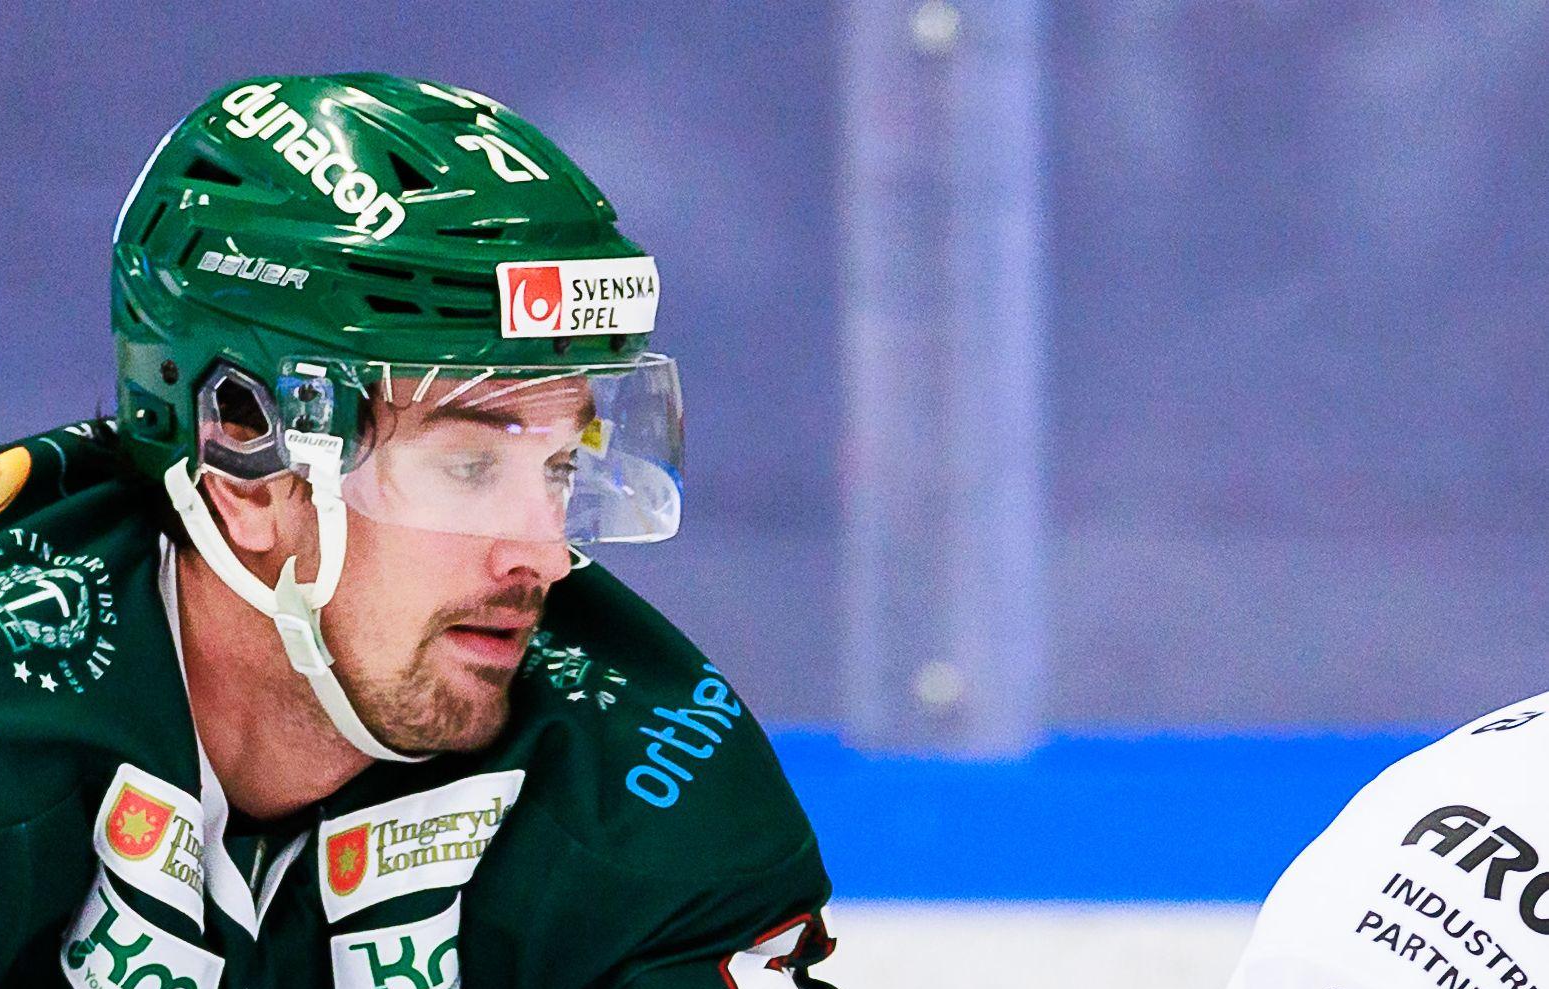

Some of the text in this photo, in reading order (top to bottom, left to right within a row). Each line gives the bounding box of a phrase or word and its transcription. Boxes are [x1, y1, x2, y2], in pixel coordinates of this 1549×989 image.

[221, 82, 406, 241] dynacon
[454, 134, 550, 183] 21
[571, 271, 655, 302] SVENSKA
[569, 306, 619, 331] SPEL
